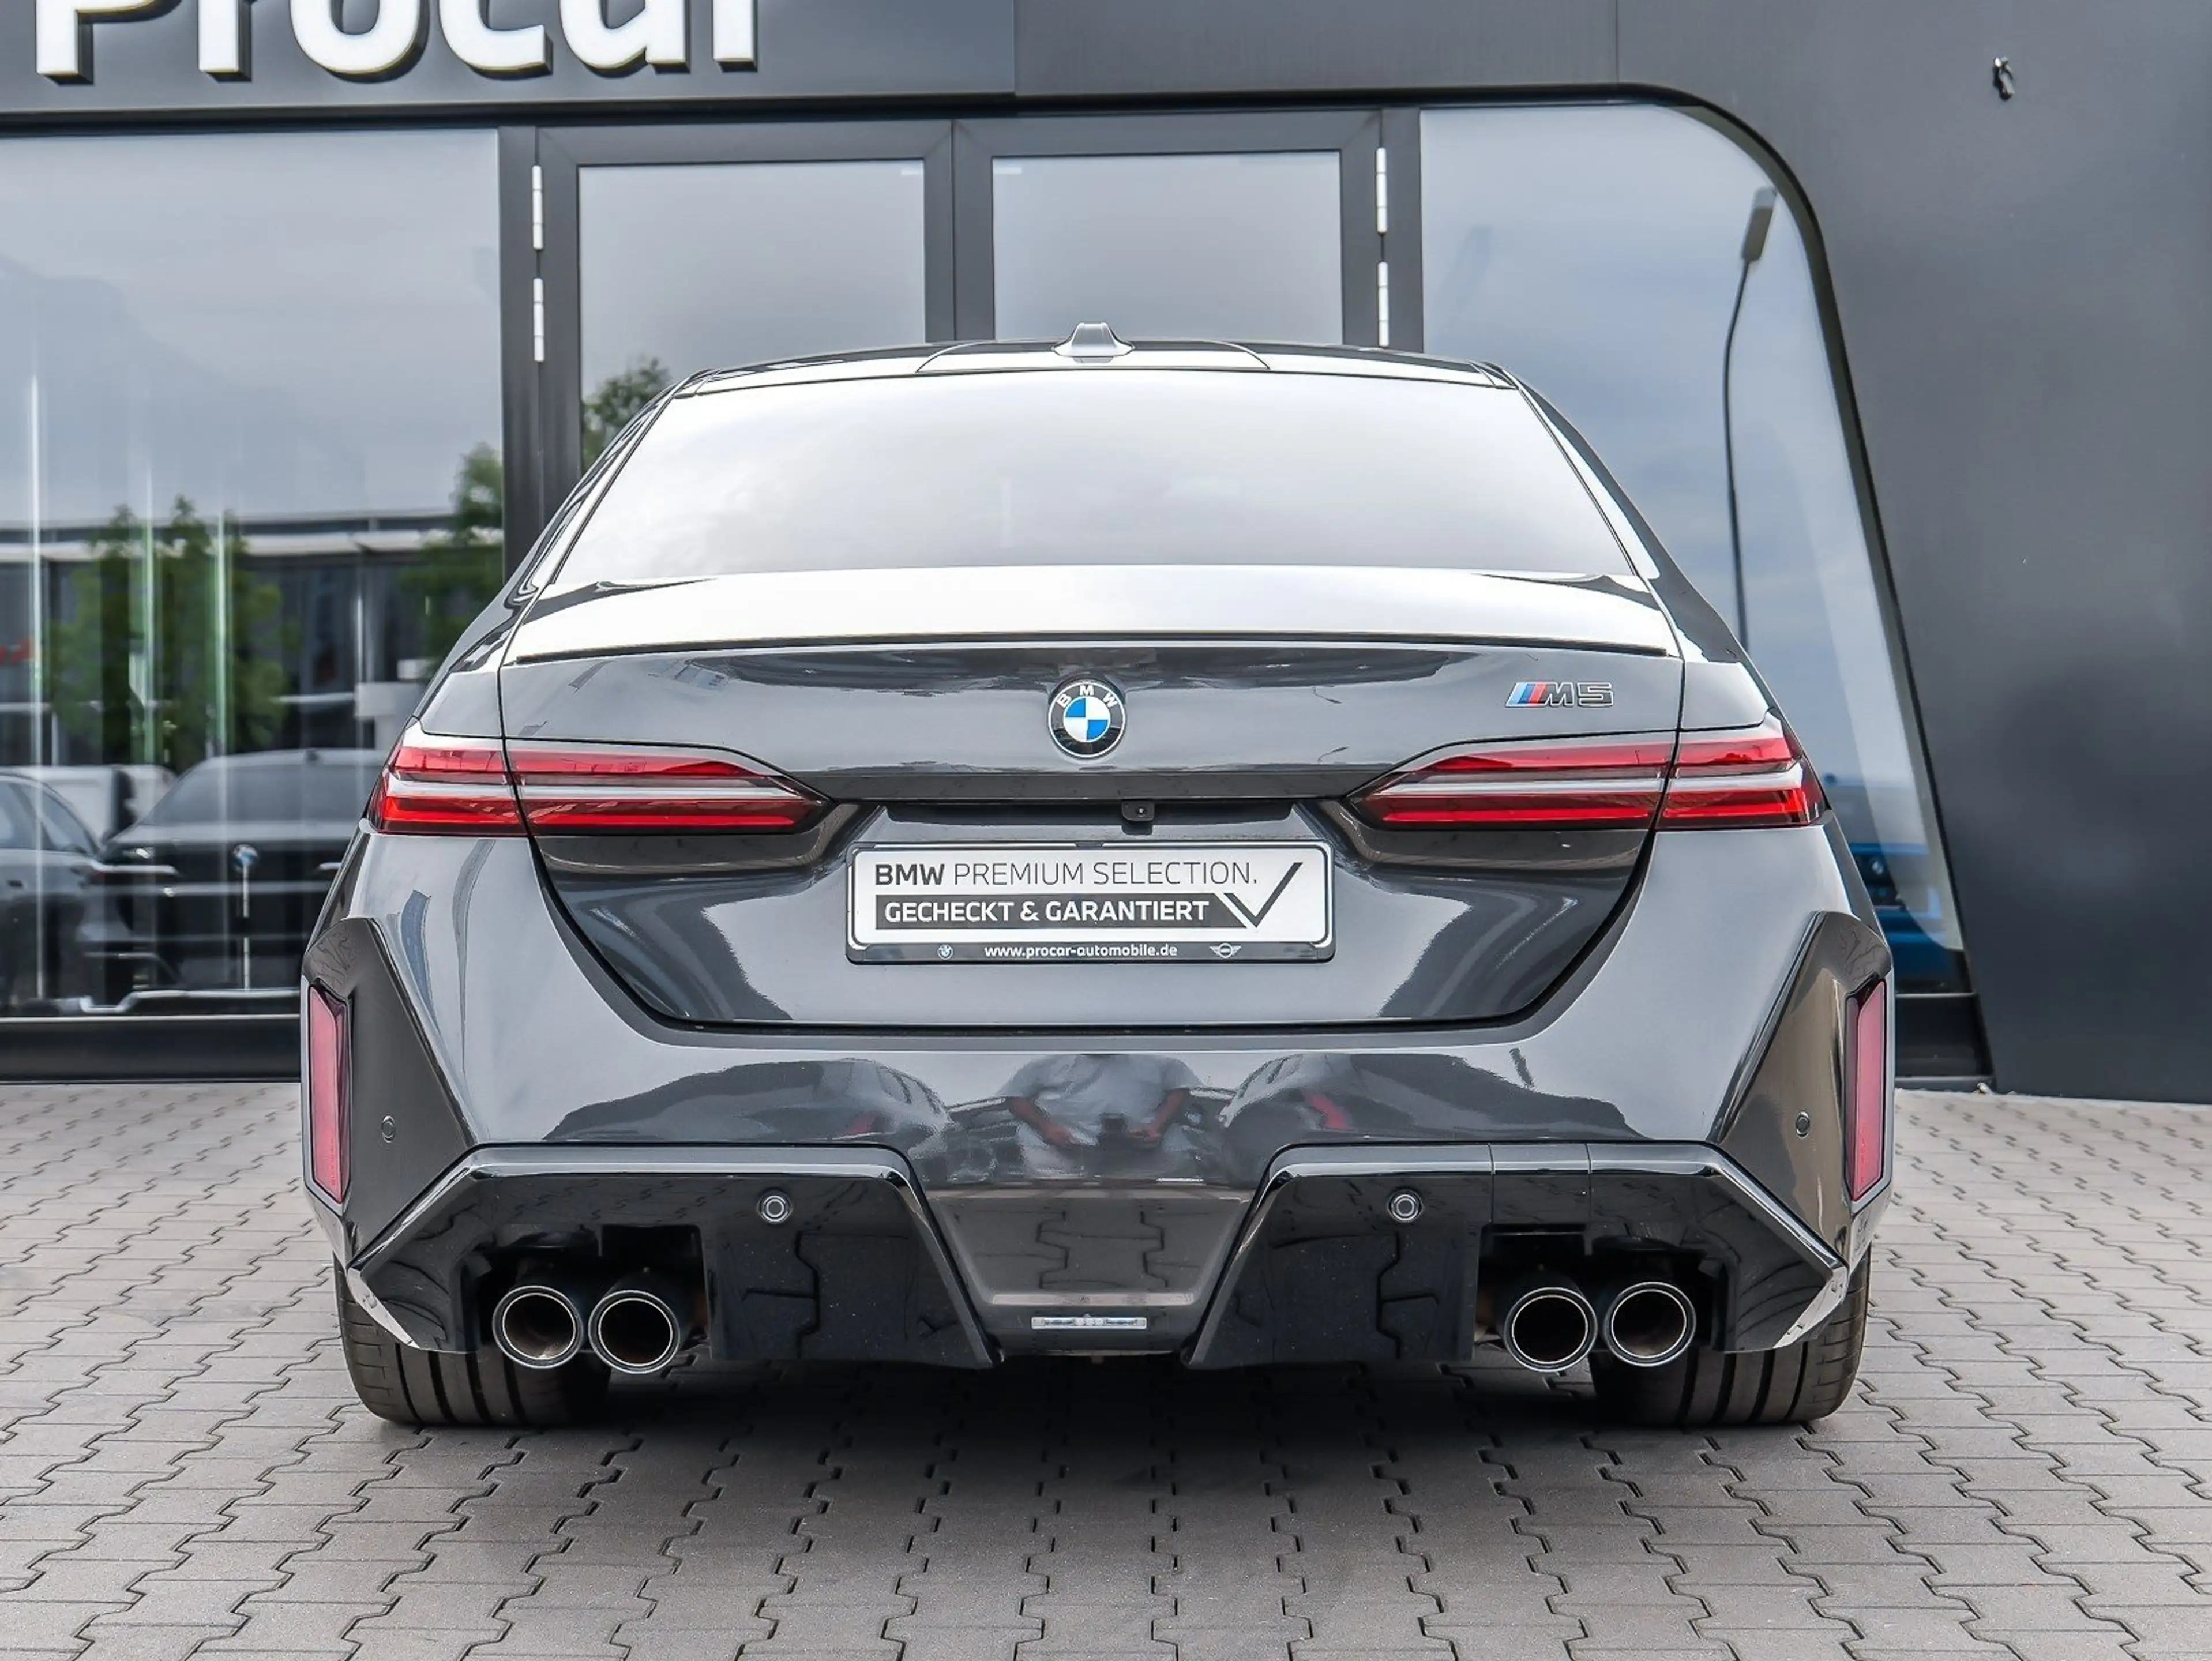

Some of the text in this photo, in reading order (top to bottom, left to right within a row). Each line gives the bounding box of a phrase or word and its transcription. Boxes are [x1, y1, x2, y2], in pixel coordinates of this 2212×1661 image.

[1056, 685, 1118, 708] BMW
[1534, 682, 1614, 707] M5
[875, 861, 1257, 886] BMW PREMIUM SELECTION.
[885, 901, 1210, 923] GECHECKT & GARANTIERT
[984, 944, 1178, 959] www.procar-automobile.de
